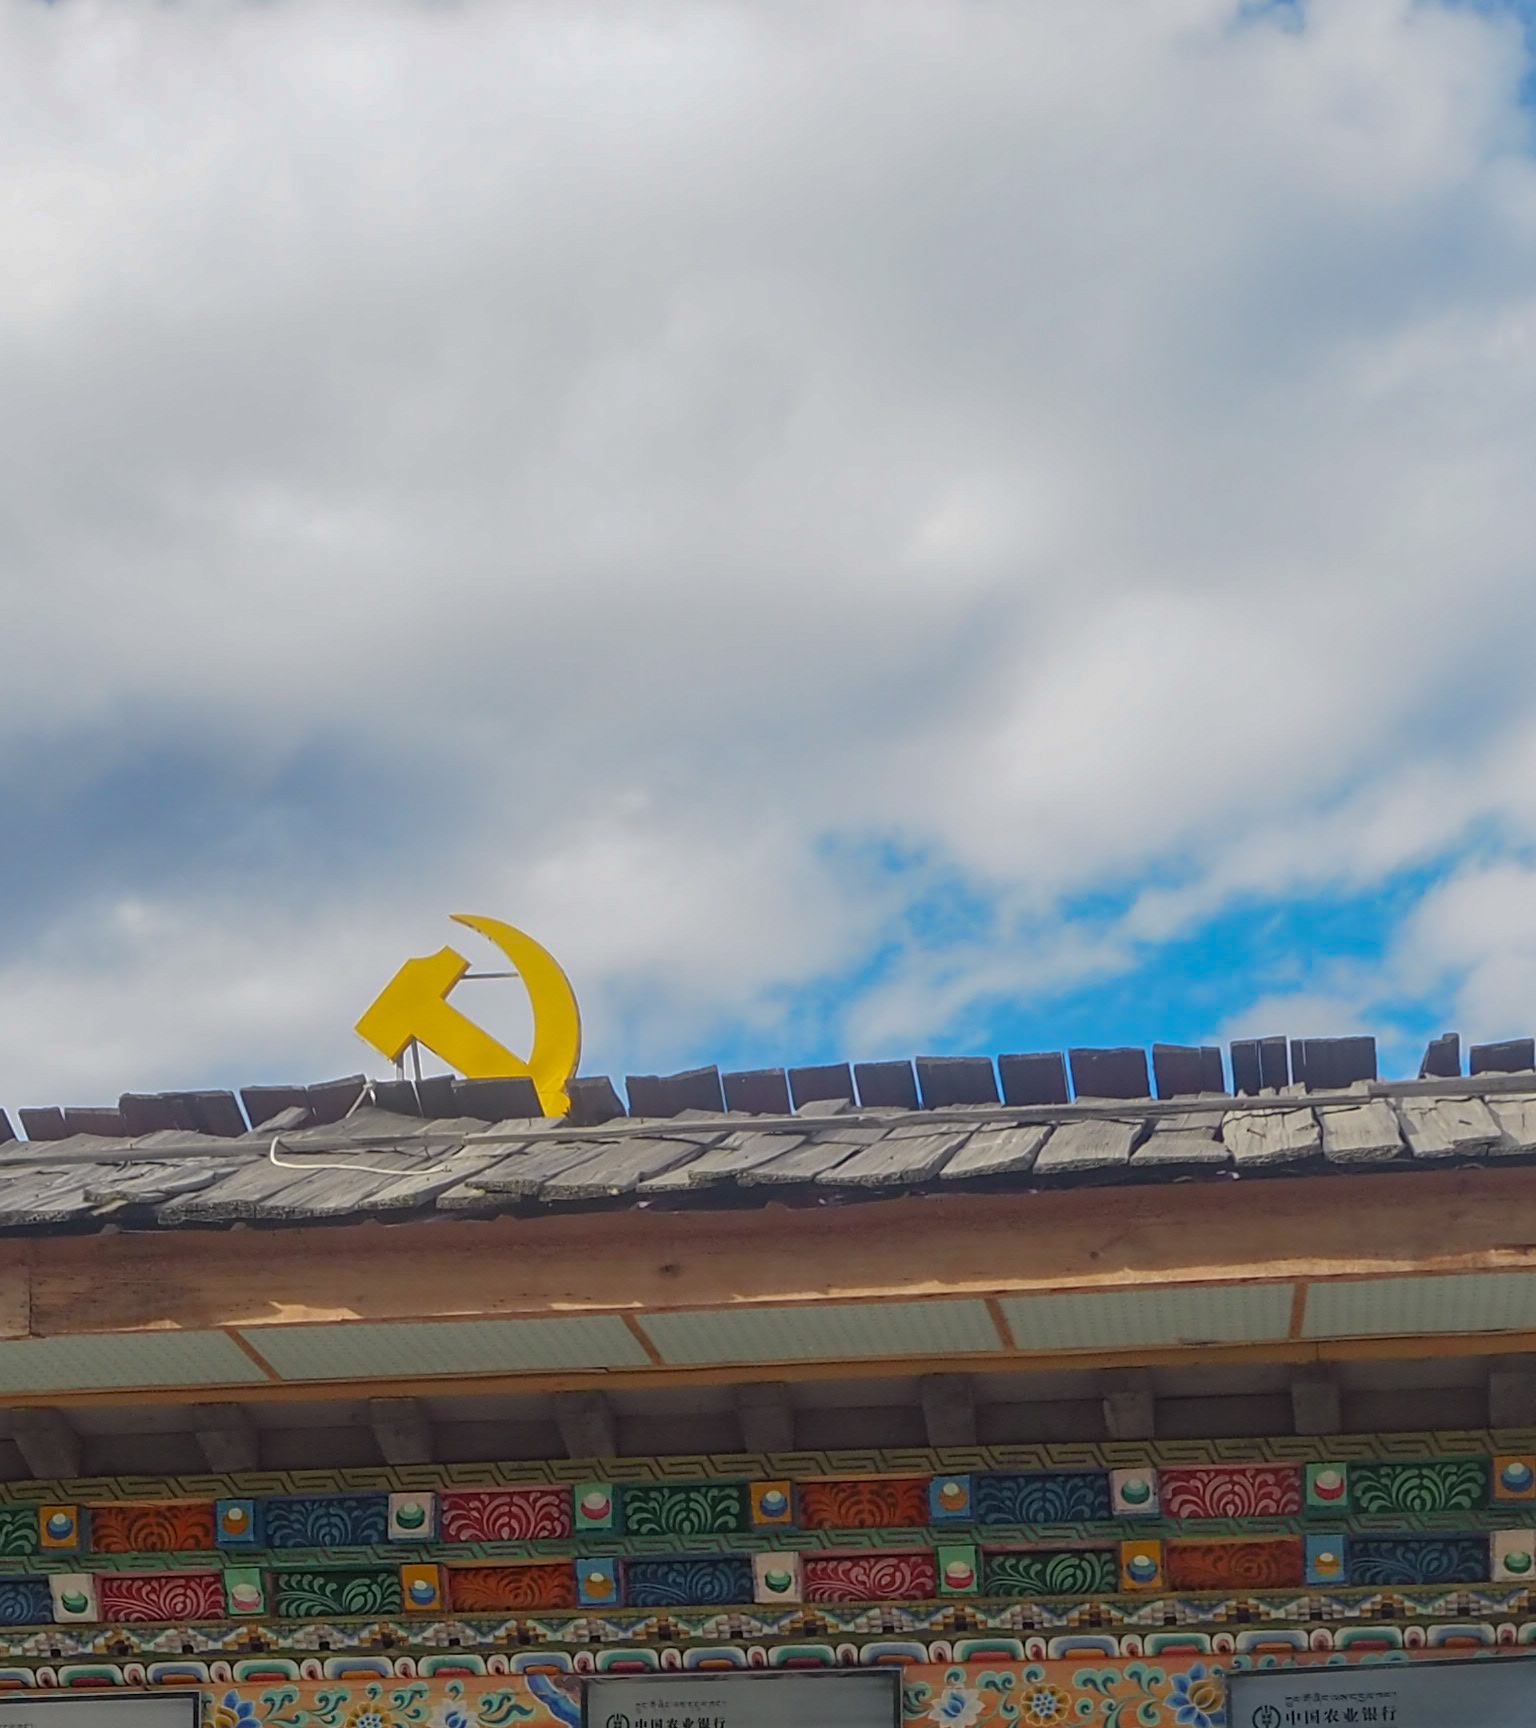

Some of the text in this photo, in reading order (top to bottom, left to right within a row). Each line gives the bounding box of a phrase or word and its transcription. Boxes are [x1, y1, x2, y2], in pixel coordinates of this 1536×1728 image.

[1285, 1705, 1397, 1726] 中国农业银行
